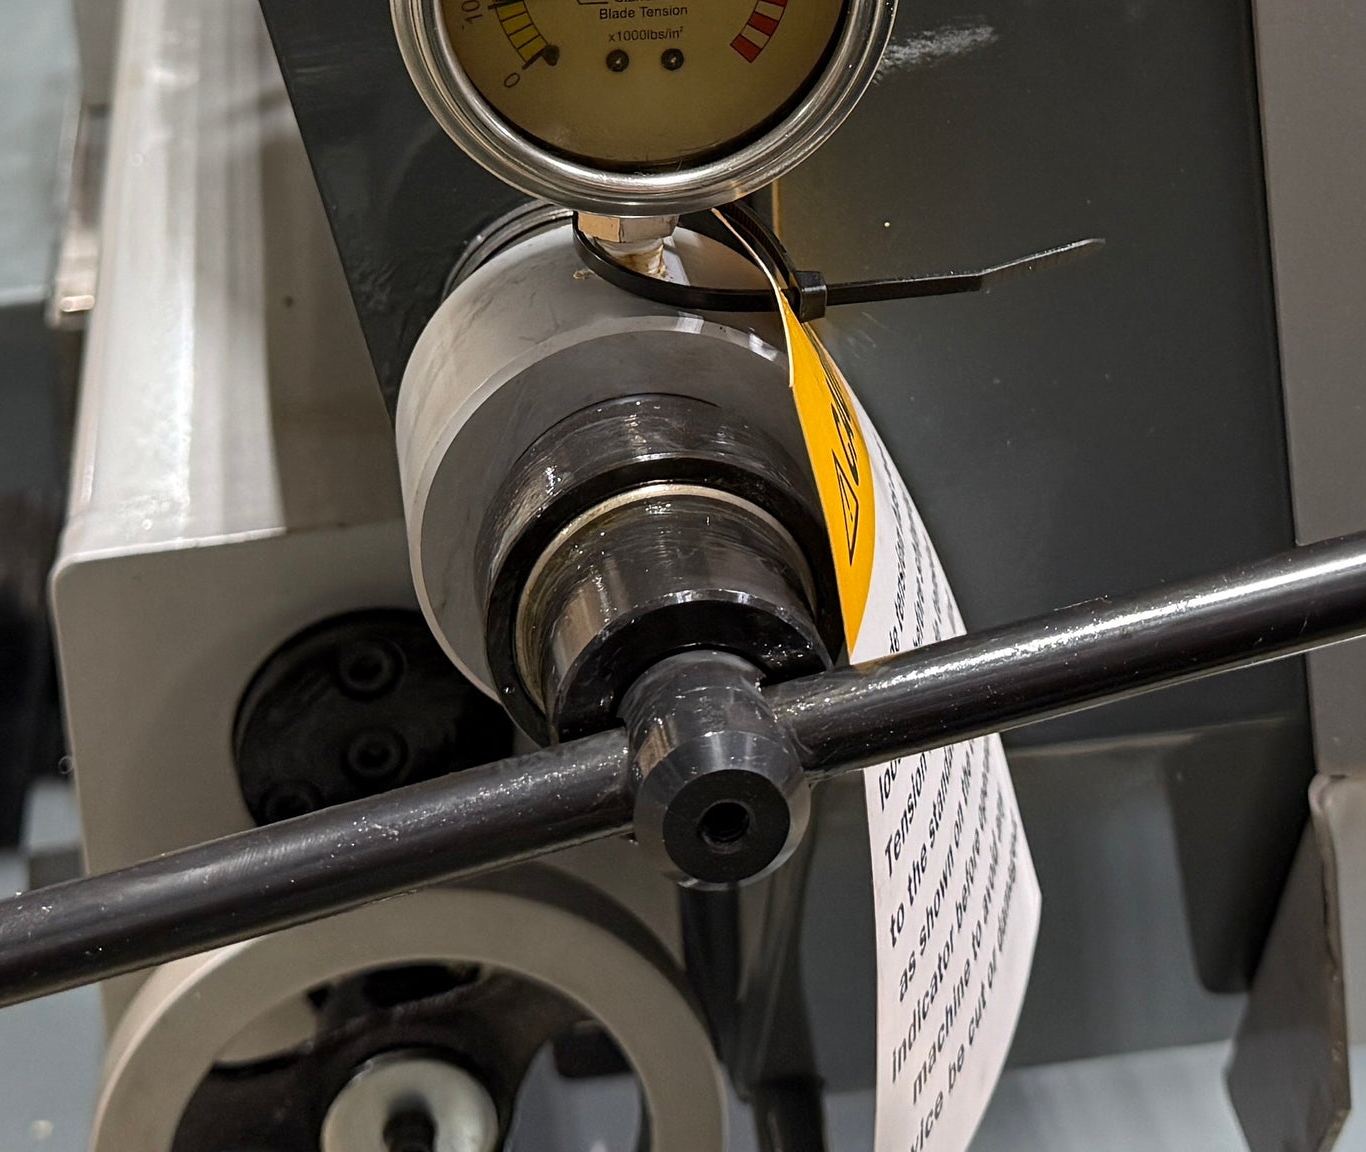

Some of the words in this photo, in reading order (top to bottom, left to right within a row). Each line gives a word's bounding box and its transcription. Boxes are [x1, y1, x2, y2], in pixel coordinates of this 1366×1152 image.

[461, 0, 483, 24] 10
[599, 8, 635, 19] Blade
[639, 6, 688, 18] Tension
[504, 72, 520, 88] 0
[885, 752, 927, 877] Tension
[899, 950, 915, 1002] as
[919, 845, 954, 956] shown
[953, 801, 964, 848] on
[961, 750, 972, 806] the
[890, 903, 904, 948] to
[908, 843, 927, 906] the
[892, 924, 954, 1083] indicator
[955, 828, 980, 933] before
[913, 958, 971, 1105] machine
[972, 920, 982, 960] to
[948, 1044, 965, 1094] be
[968, 981, 986, 1046] cut
[988, 945, 997, 989] or
